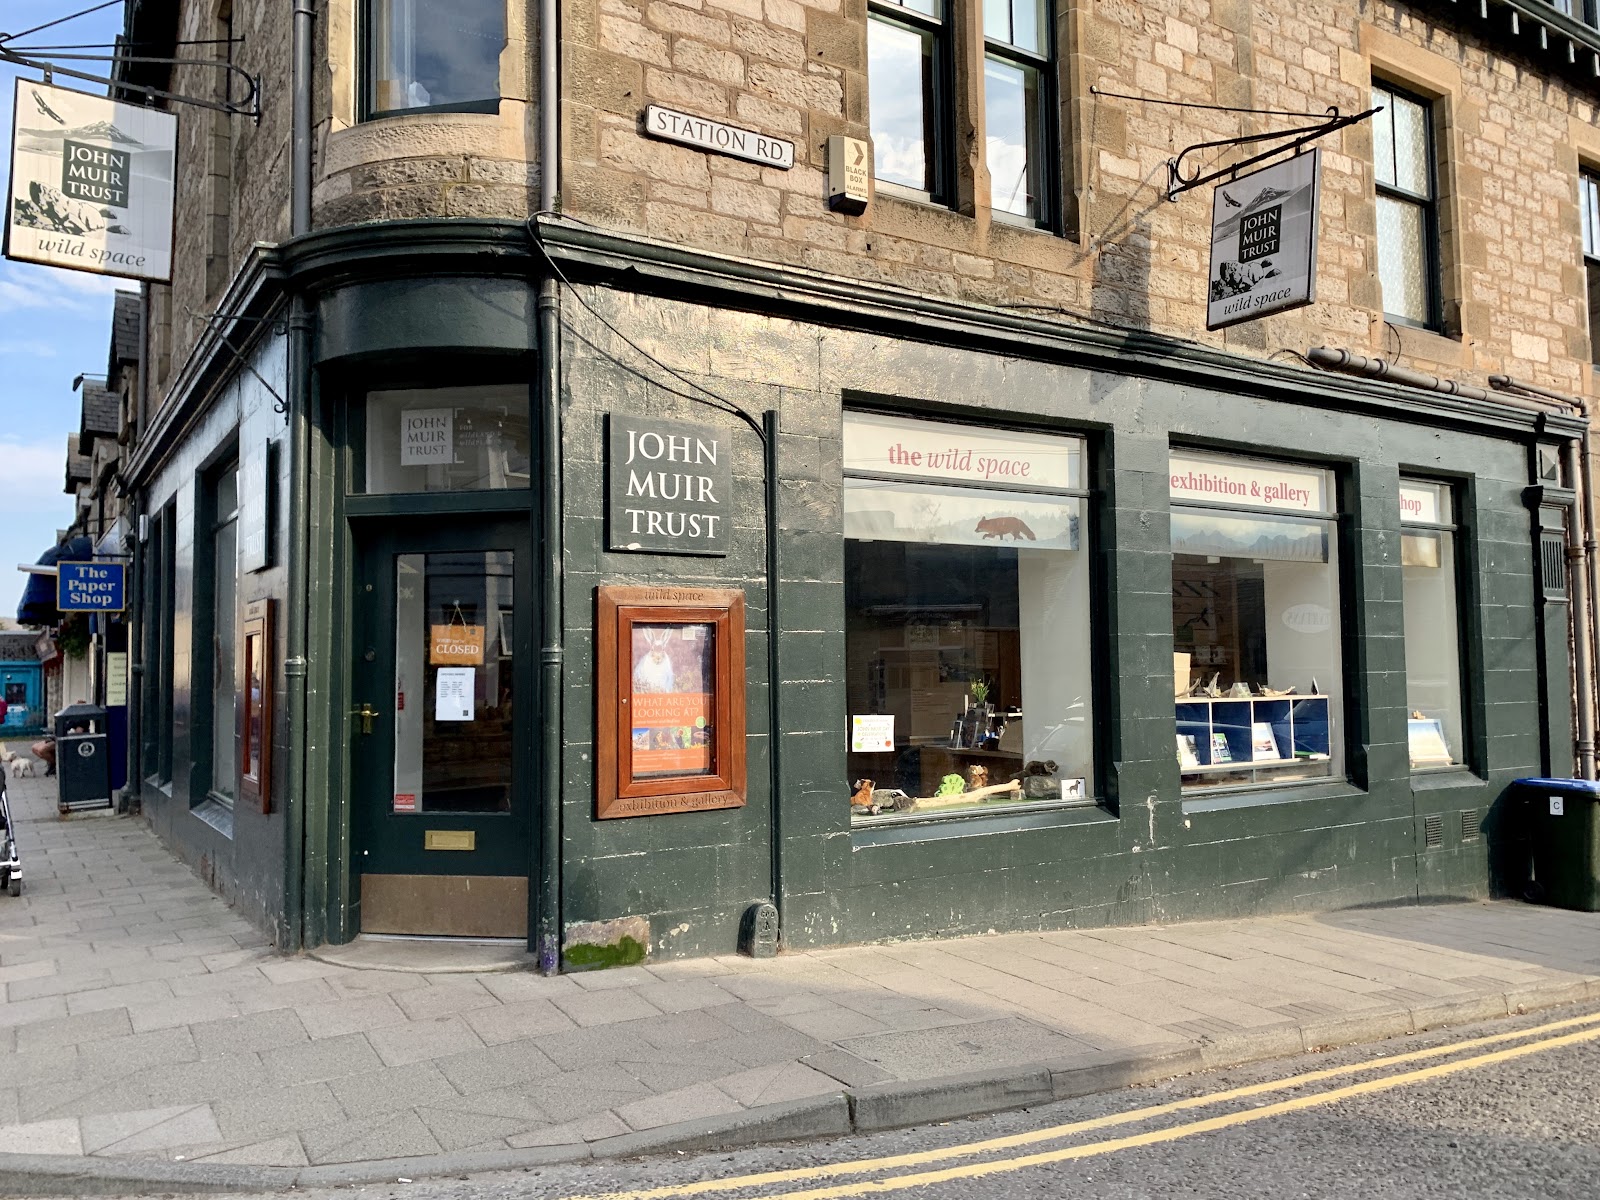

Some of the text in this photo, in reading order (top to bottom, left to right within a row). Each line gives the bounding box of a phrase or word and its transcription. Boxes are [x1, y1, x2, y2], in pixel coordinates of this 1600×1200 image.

[656, 112, 787, 162] STATION RD.
[68, 146, 124, 168] JOHN
[68, 164, 122, 186] MUIR
[846, 166, 866, 176] BLACK
[850, 175, 863, 183] BOX
[67, 180, 124, 202] TRUST
[846, 185, 867, 193] ALARMS
[1243, 210, 1278, 233] JOHN
[1242, 226, 1276, 246] MUIR
[38, 238, 146, 267] wild space
[1242, 240, 1277, 260] TRUST
[1224, 287, 1291, 315] wild space
[407, 416, 446, 431] JOHN
[407, 431, 446, 442] MUIR
[408, 445, 446, 456] TRUST
[625, 430, 719, 466] JOHN
[888, 444, 1030, 479] the wild space
[626, 469, 720, 503] MUIR
[1170, 472, 1310, 507] exhibition & gallery
[1400, 494, 1421, 515] hop
[624, 509, 720, 539] TRUST
[75, 567, 108, 578] The
[68, 579, 116, 593] Paper
[70, 592, 112, 607] Shop
[672, 592, 704, 603] space
[436, 644, 479, 655] CLOSED
[633, 696, 707, 707] WHAT ARE YOU
[633, 706, 699, 717] LOOKING AT?
[619, 793, 728, 812] exhibition & gallery
[1553, 802, 1560, 810] C
